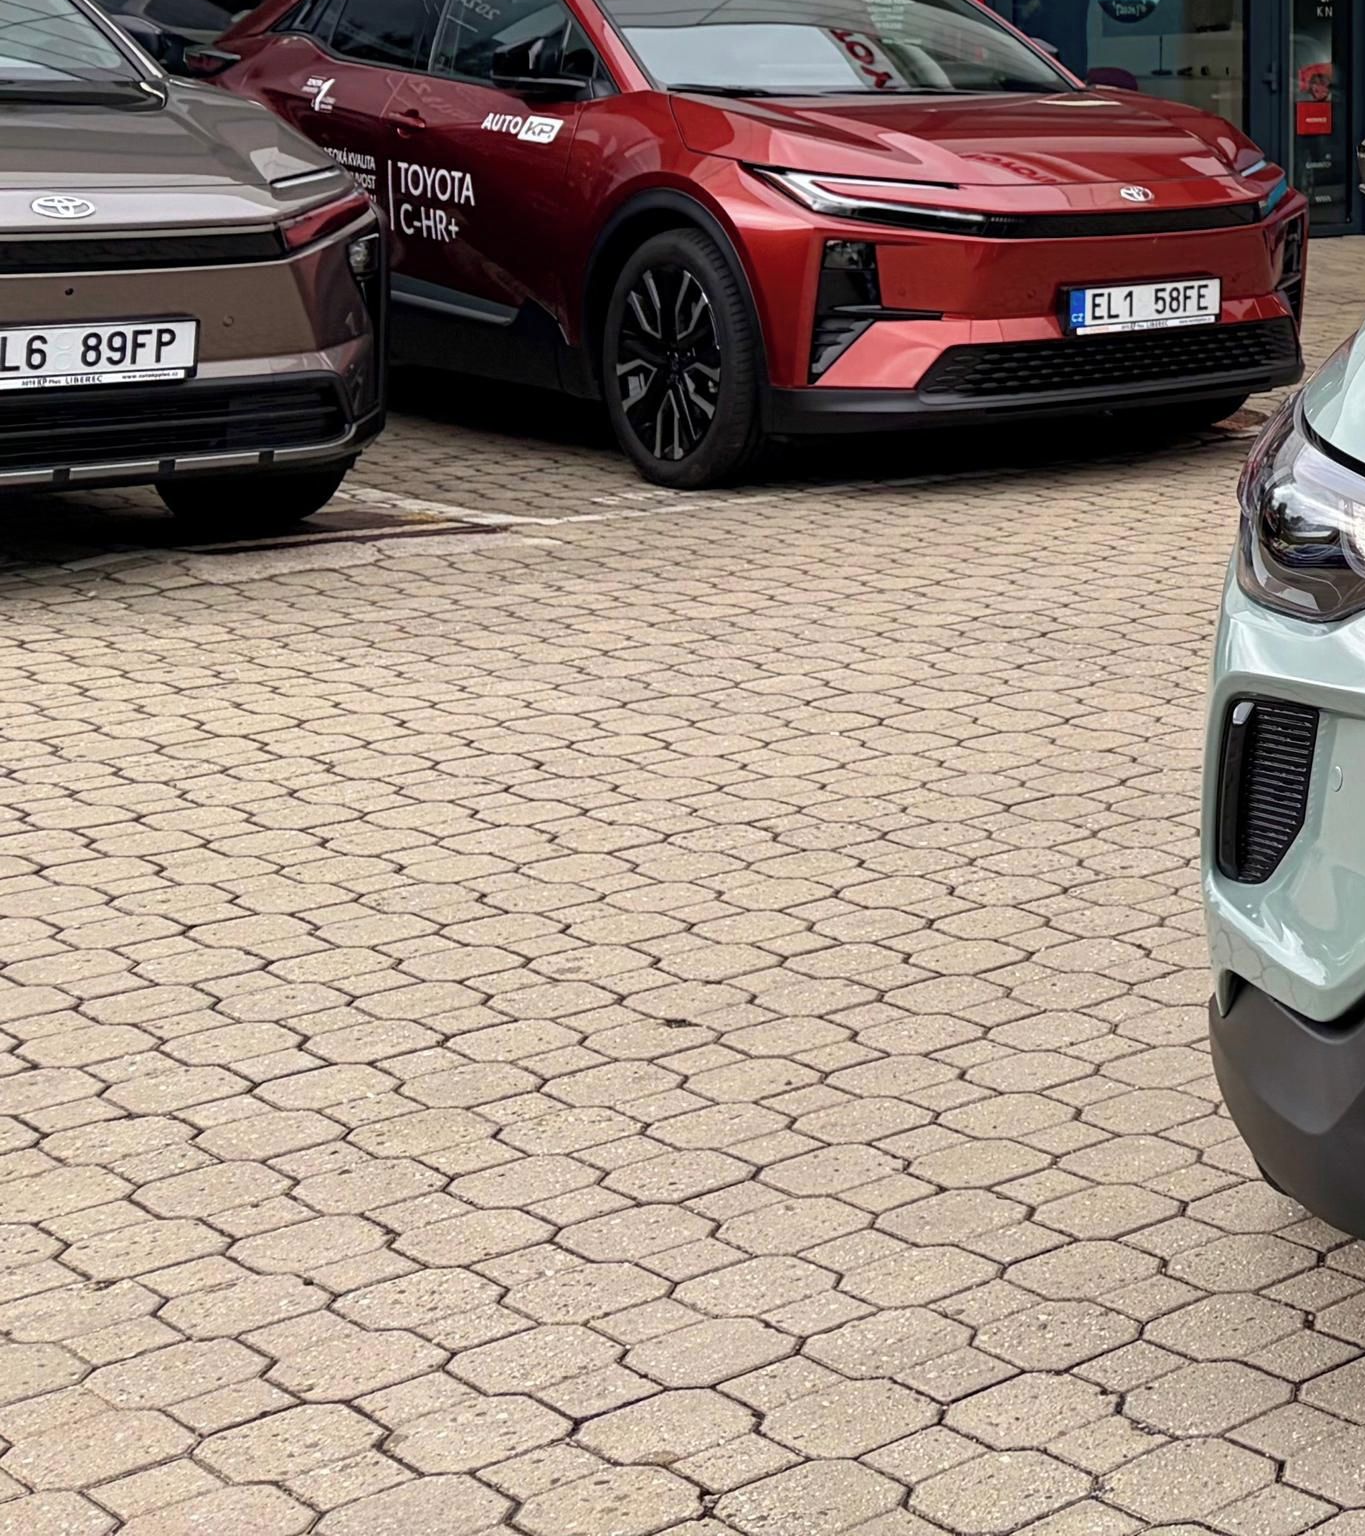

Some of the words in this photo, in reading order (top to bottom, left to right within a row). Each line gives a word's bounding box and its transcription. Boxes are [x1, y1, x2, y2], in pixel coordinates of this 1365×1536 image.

[481, 112, 522, 135] AUTO
[398, 161, 476, 207] TOYOTA
[400, 202, 460, 243] C-HR+
[1071, 313, 1084, 323] CZ
[1091, 290, 1133, 321] EL1
[1154, 284, 1209, 314] 58FE
[81, 328, 176, 367] 89FP
